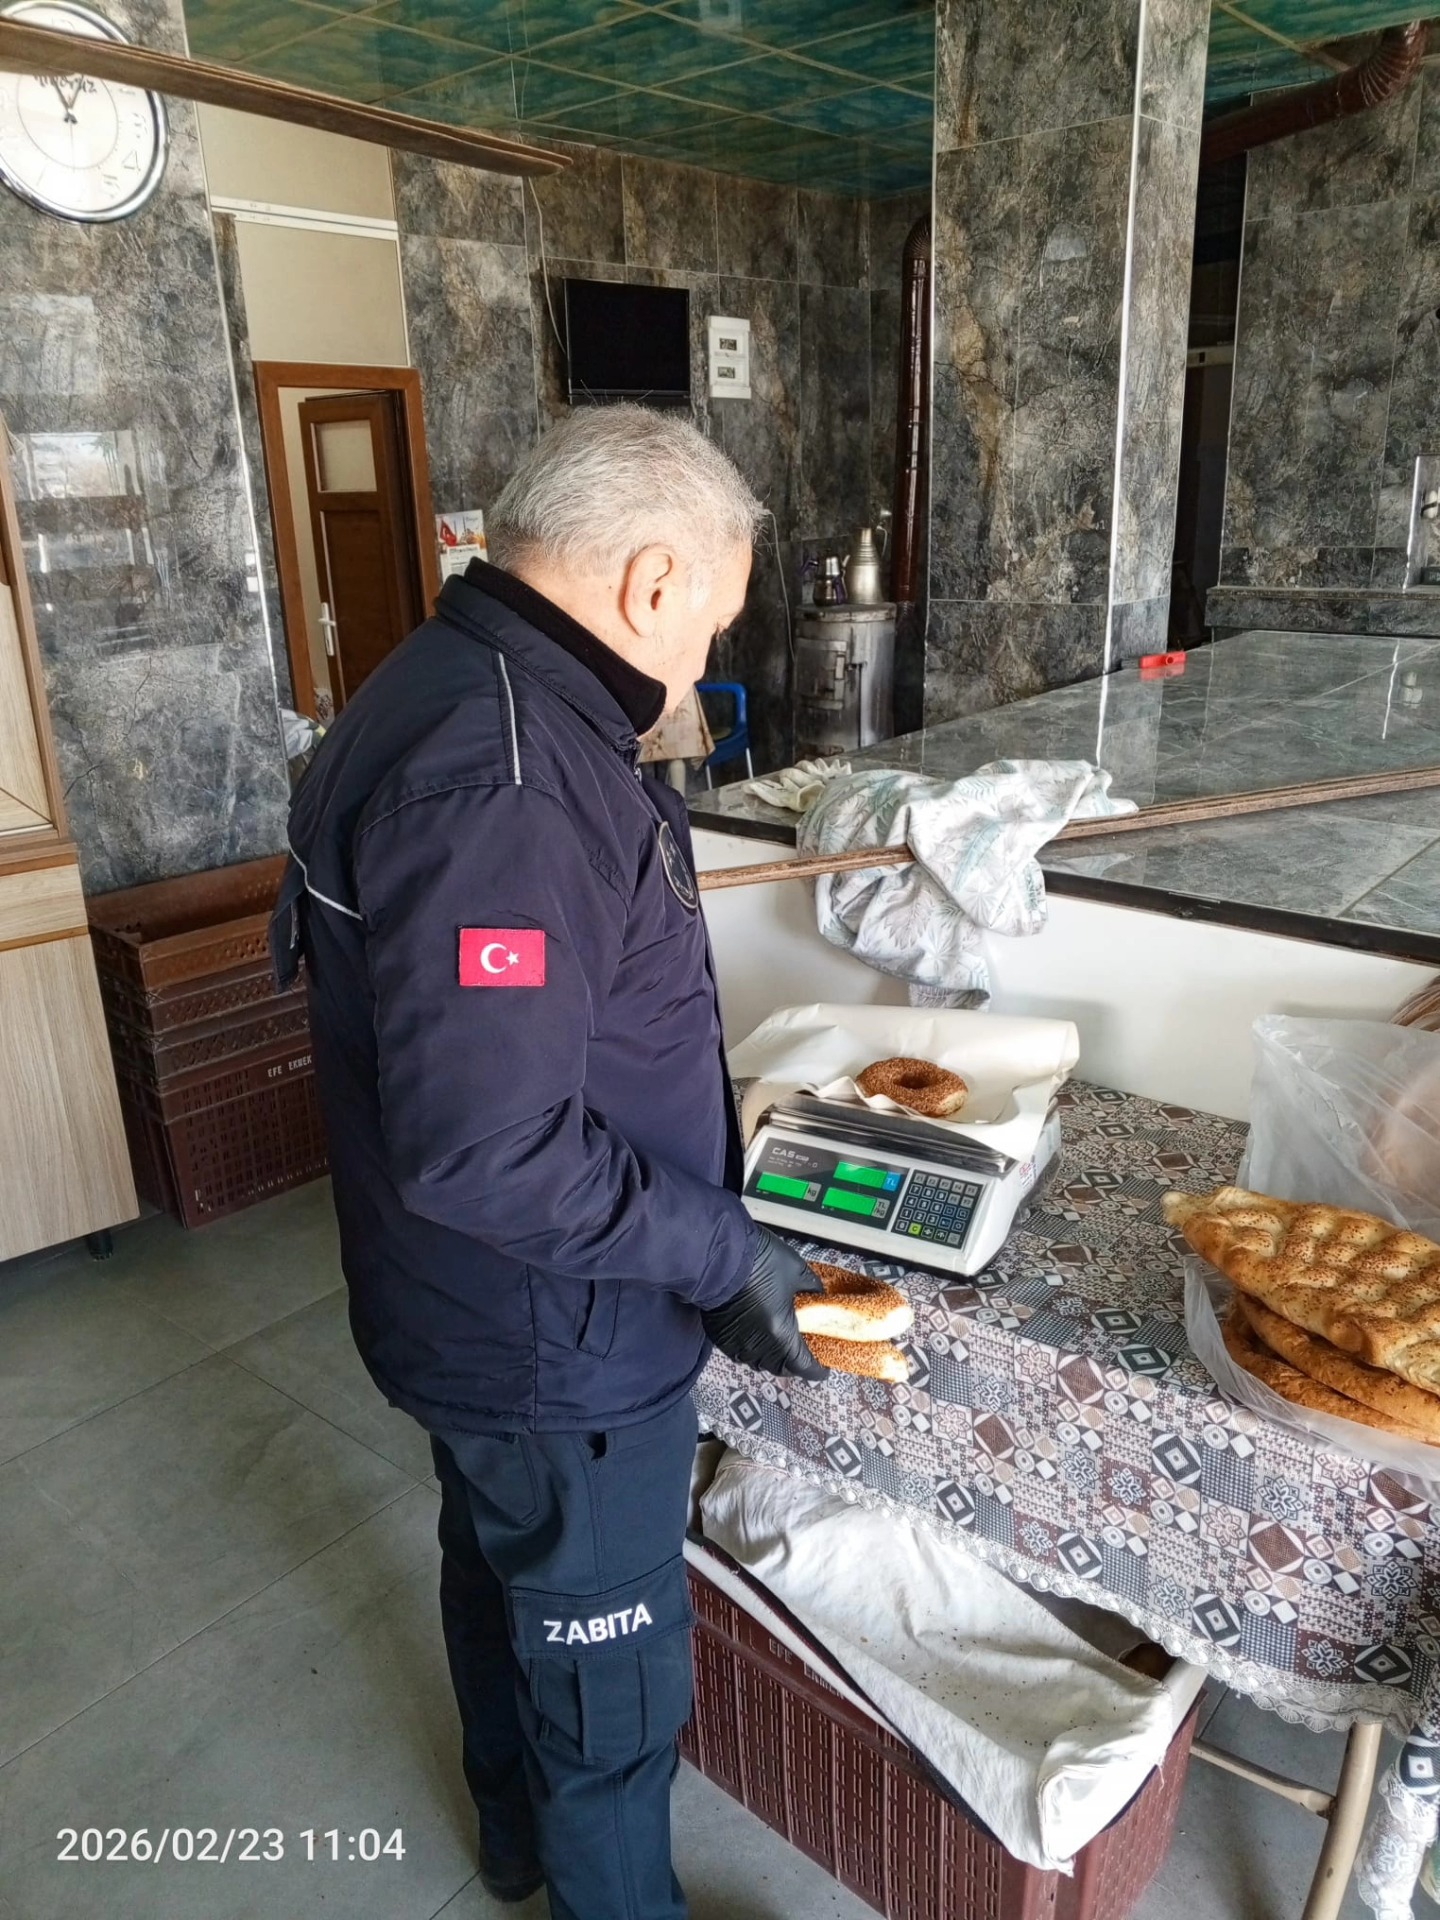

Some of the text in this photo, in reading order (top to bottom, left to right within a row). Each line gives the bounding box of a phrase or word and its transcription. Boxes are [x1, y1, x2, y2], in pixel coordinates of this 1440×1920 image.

[267, 1065, 282, 1078] EFE
[771, 1147, 796, 1159] CAS
[886, 1177, 895, 1186] TL
[807, 1186, 817, 1198] kg
[878, 1201, 886, 1209] TL
[543, 1602, 653, 1645] ZABITA
[768, 1638, 792, 1665] EFE
